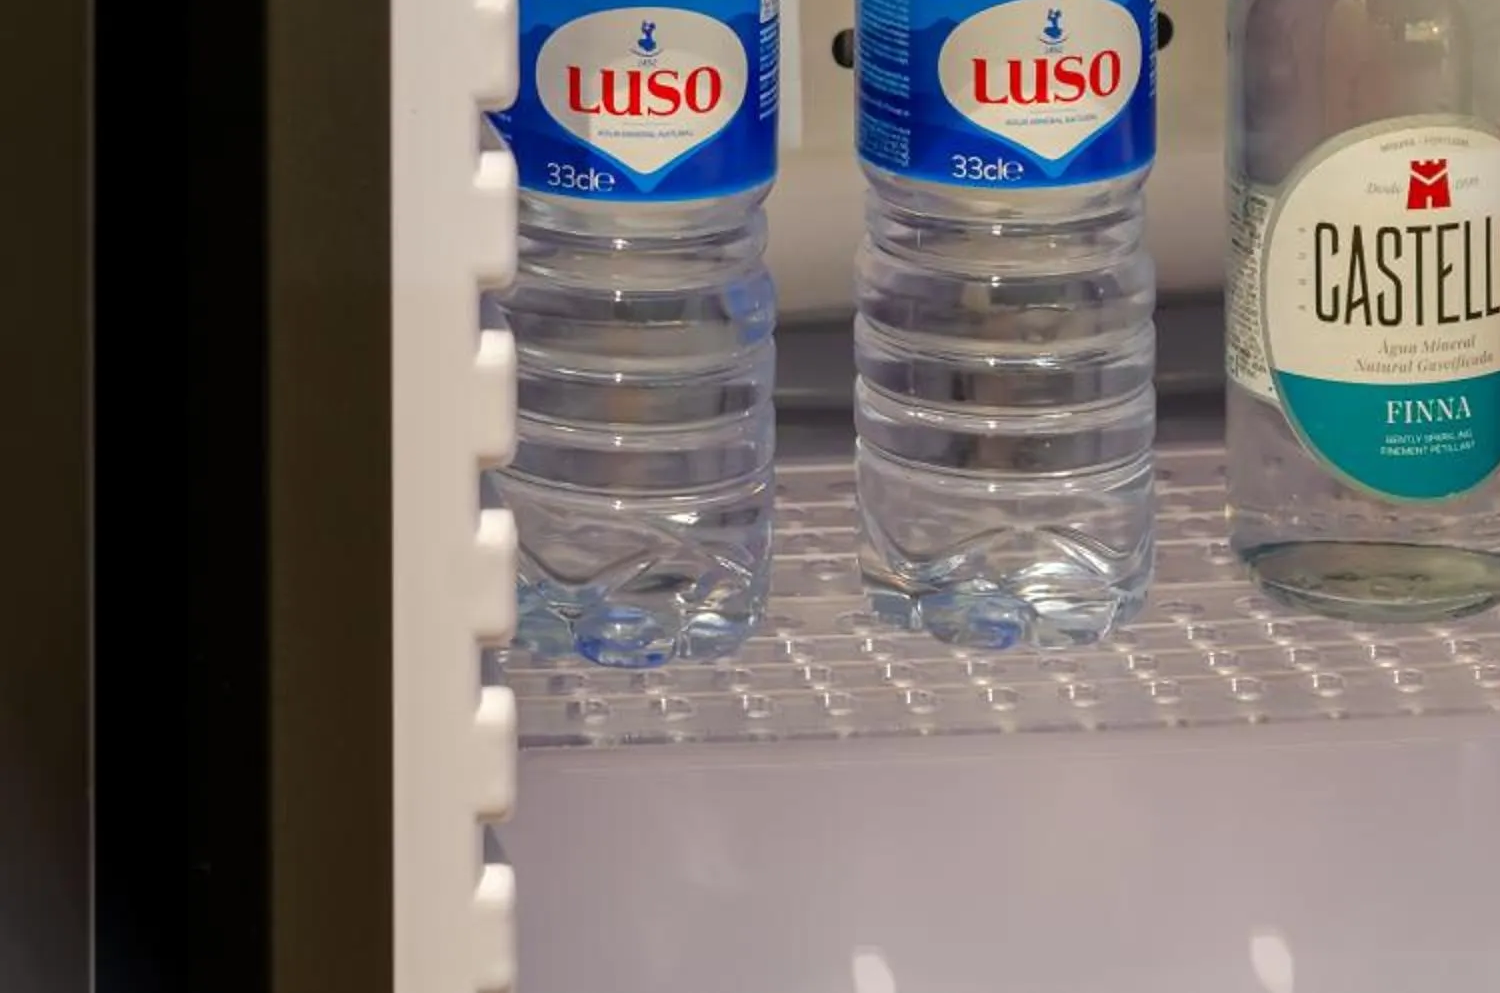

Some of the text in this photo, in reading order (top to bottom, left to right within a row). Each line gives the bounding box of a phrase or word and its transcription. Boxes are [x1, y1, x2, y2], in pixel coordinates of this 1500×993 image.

[566, 65, 722, 117] LUSO
[972, 50, 1121, 106] LUSO
[1421, 334, 1477, 354] Mineral
[1353, 359, 1414, 374] Natural
[1385, 395, 1472, 424] FINNA
